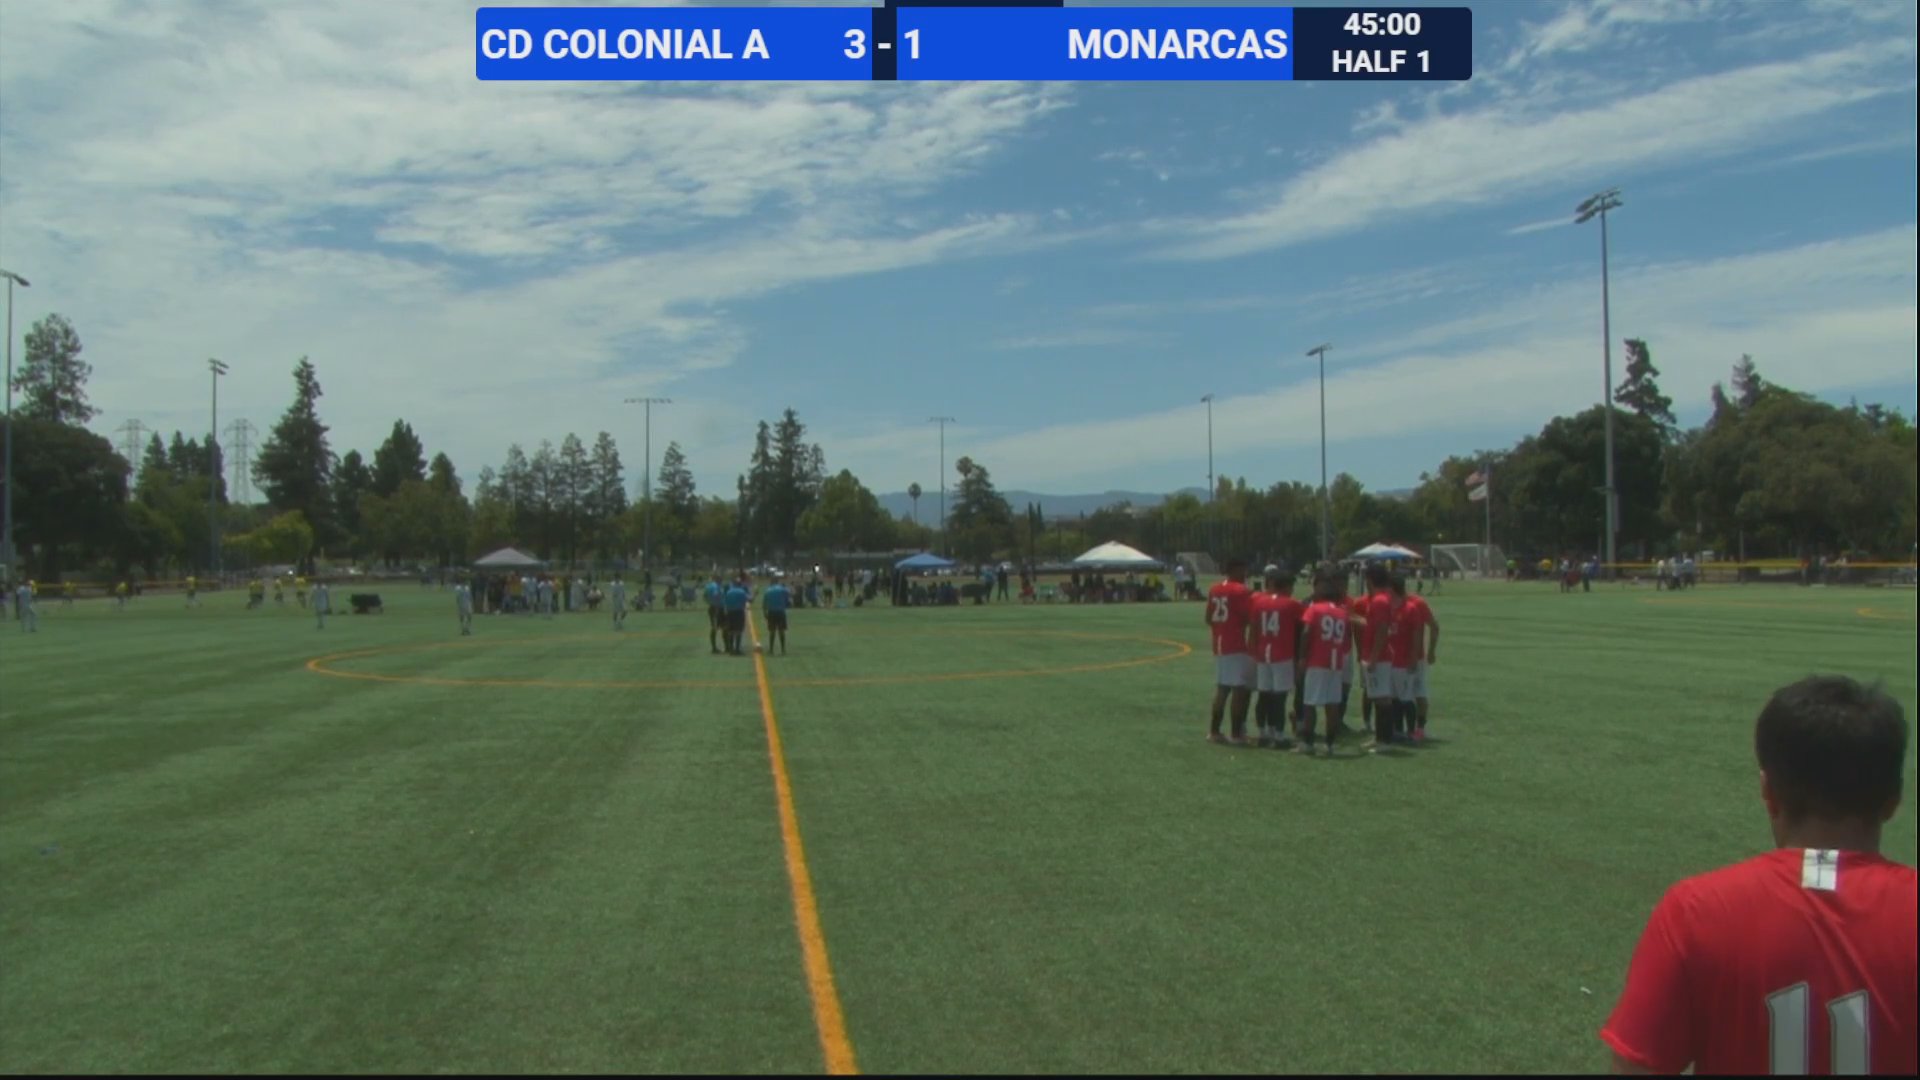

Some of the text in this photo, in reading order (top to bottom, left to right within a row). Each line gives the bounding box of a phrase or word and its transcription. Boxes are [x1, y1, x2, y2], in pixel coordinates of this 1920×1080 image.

[1212, 598, 1228, 622] 25
[1261, 611, 1280, 637] 14
[1321, 615, 1345, 643] 99
[1764, 981, 1869, 1075] 11
